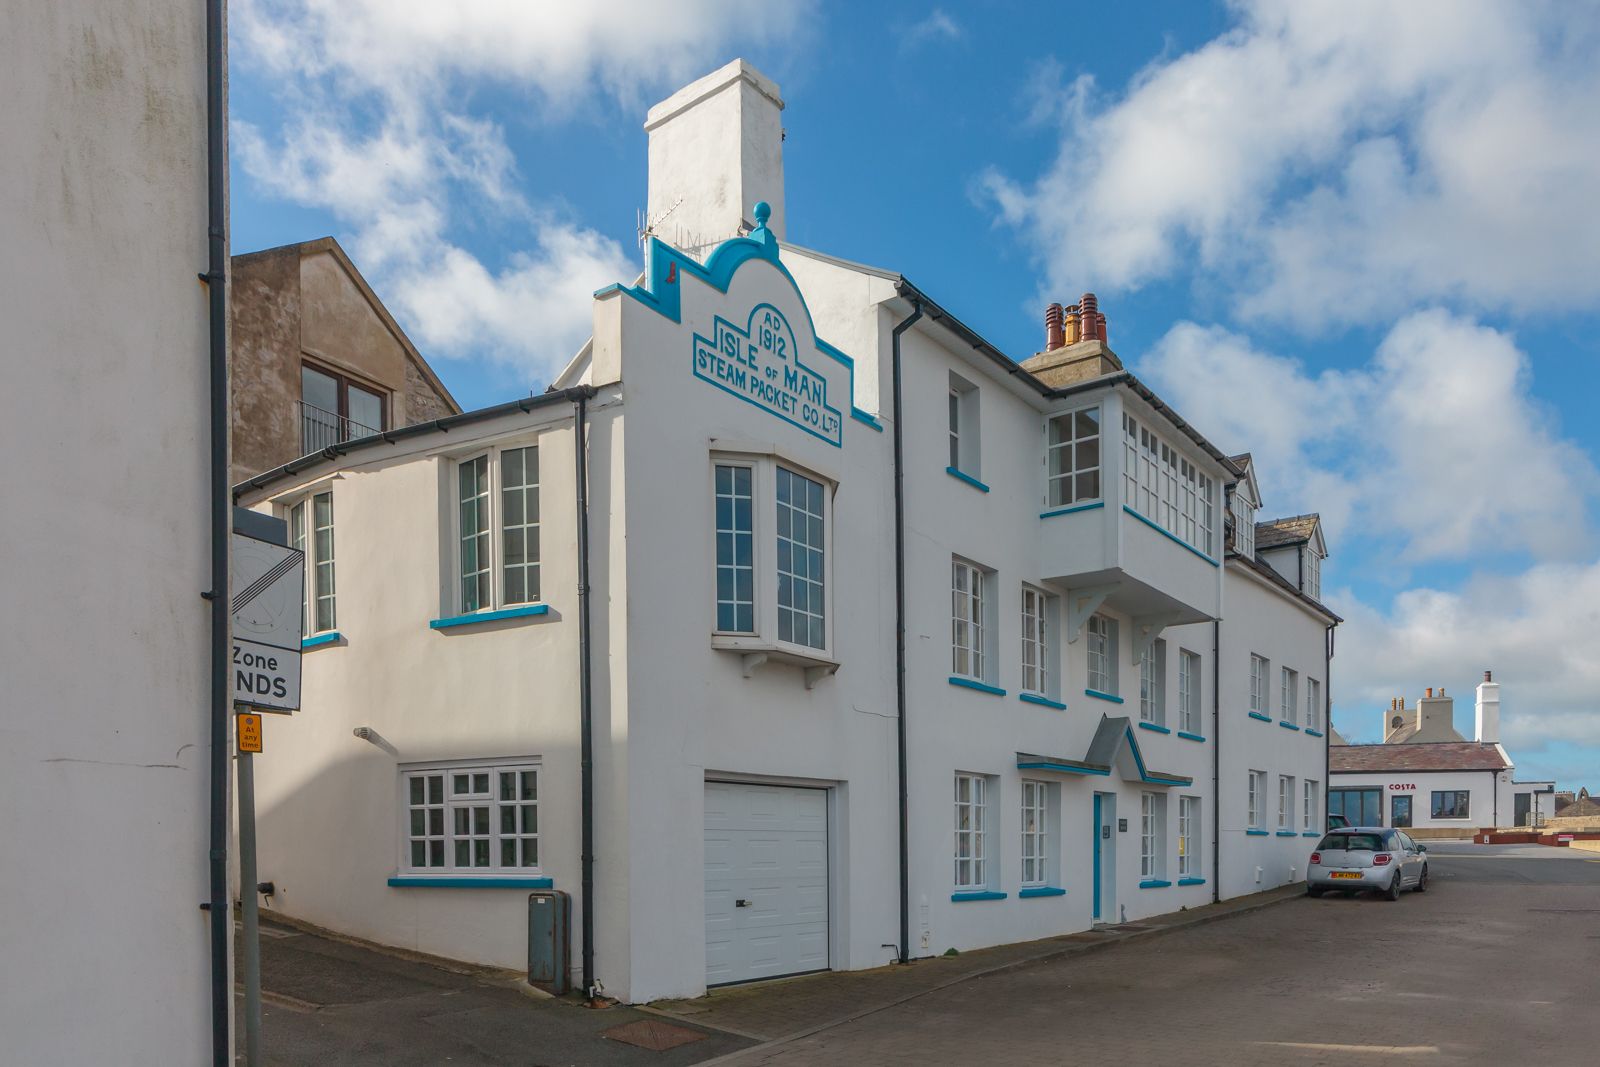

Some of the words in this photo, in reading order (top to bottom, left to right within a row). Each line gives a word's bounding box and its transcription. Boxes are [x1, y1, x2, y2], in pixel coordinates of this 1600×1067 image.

[764, 312, 781, 331] AD
[759, 325, 787, 360] 1912
[698, 349, 746, 390] STEAM
[750, 375, 797, 415] PACKET
[720, 328, 758, 371] ISLE
[765, 366, 778, 380] OF
[784, 365, 822, 406] MAN
[233, 646, 278, 671] Zone
[236, 670, 287, 698] NDS
